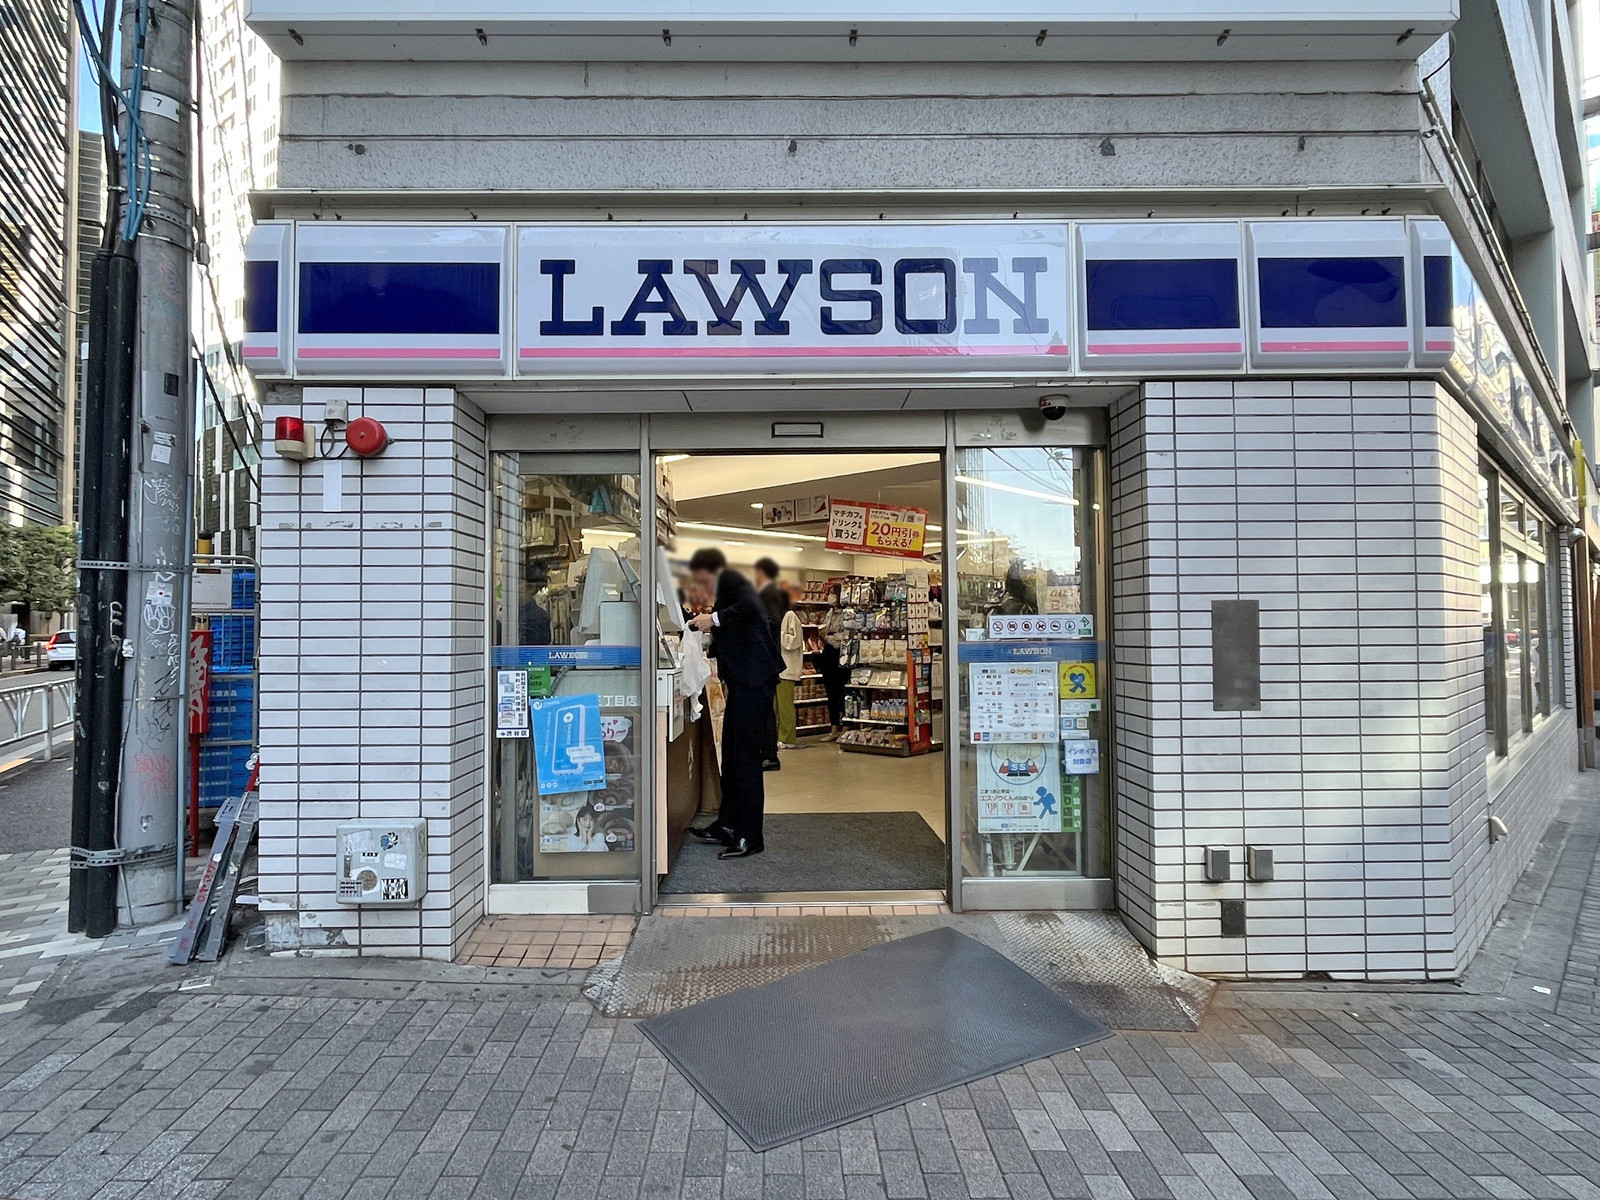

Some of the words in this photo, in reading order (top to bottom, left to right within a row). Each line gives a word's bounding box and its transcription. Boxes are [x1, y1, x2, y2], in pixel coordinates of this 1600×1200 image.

[539, 257, 1048, 336] LAWSON
[834, 528, 858, 540] 買うと
[1012, 647, 1052, 655] LAWSON
[1010, 763, 1027, 771] SS
